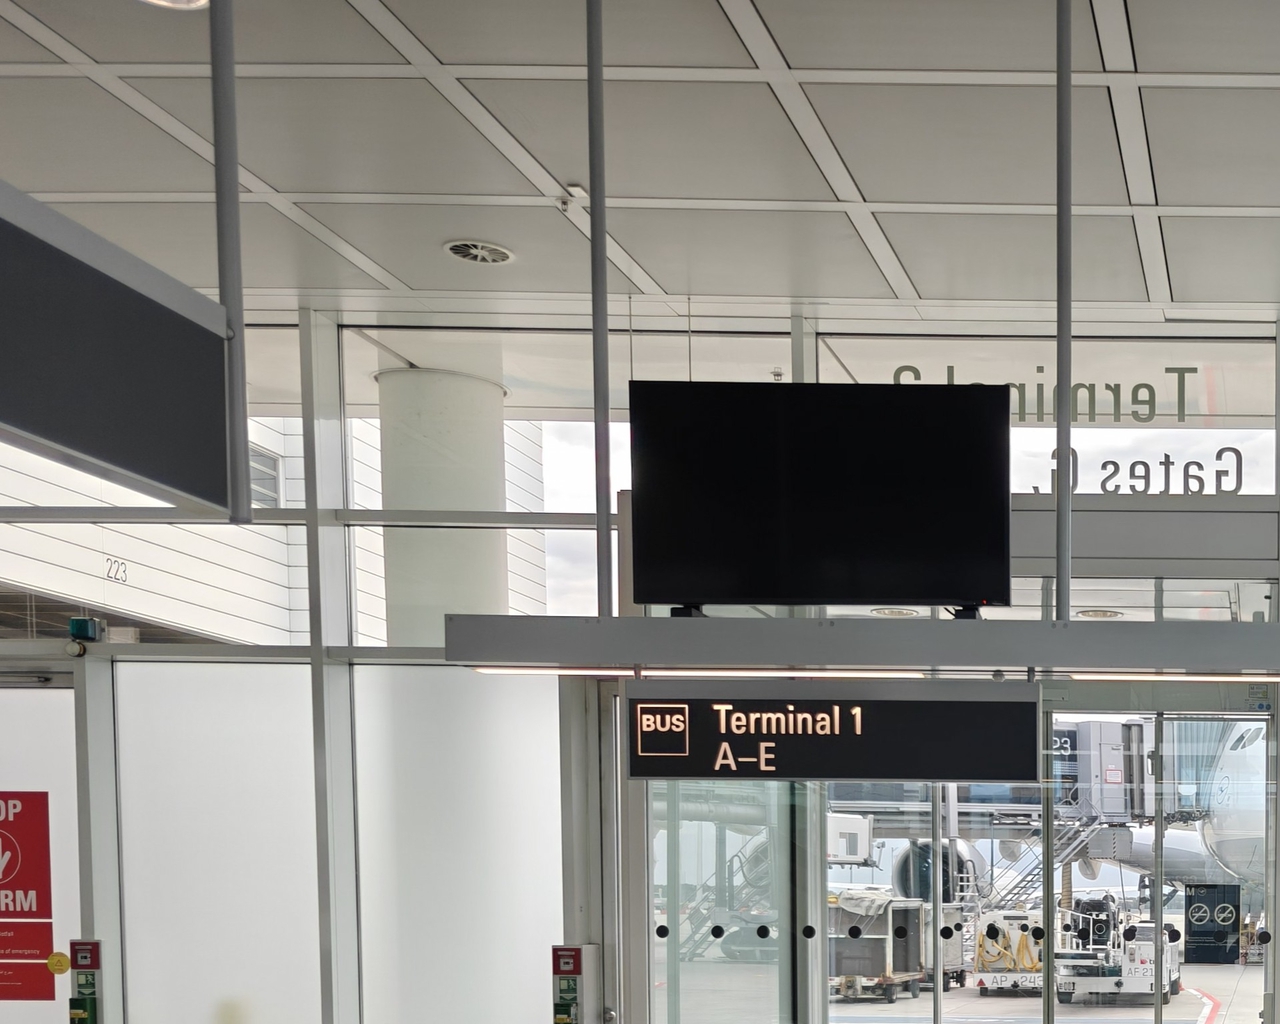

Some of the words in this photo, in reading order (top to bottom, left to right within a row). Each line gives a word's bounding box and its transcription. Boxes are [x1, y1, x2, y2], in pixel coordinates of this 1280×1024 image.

[105, 557, 128, 584] 223
[641, 714, 685, 732] BUS
[713, 705, 840, 735] Terminal
[851, 707, 862, 735] 1
[991, 976, 1007, 986] AP
